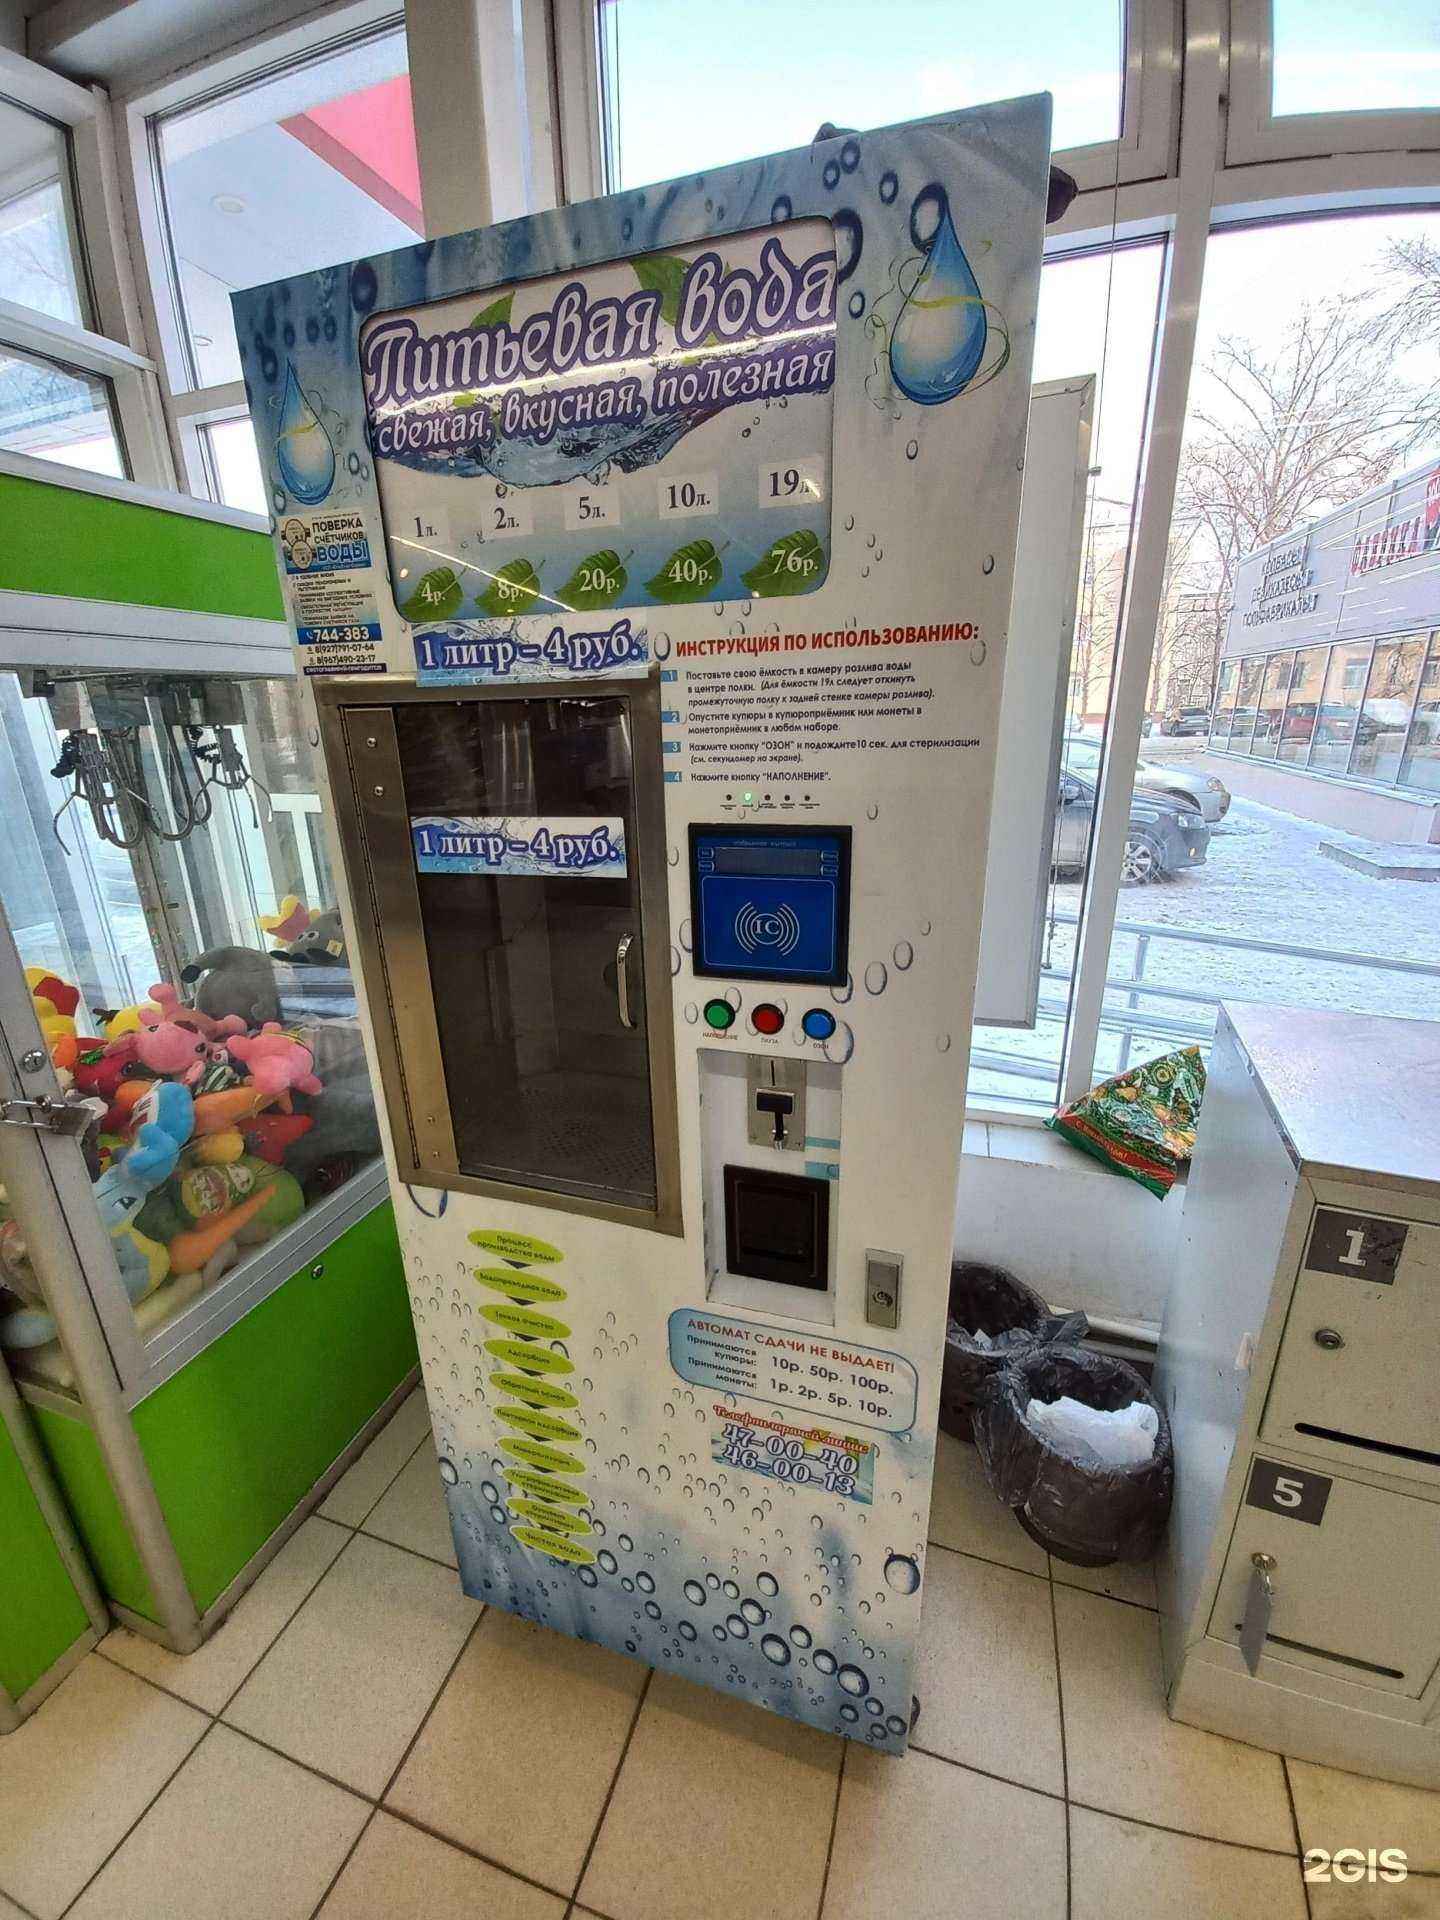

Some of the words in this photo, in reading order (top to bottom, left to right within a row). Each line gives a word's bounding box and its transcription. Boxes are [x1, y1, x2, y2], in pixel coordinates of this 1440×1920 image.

[365, 287, 658, 402] Питьевая
[679, 244, 837, 345] вода
[378, 409, 491, 453] свежая,
[504, 384, 643, 439] вкусная,
[655, 349, 834, 409] полезная
[769, 469, 816, 497] 19л
[578, 496, 606, 520] 5л.
[666, 482, 711, 510] 10л.
[312, 518, 364, 533] ПОВЕРКА
[413, 516, 438, 538] 1л.
[493, 507, 520, 530] 2л.
[314, 531, 364, 545] СЧЁТЧИКОВ
[316, 540, 369, 563] ВОДЫ
[770, 547, 819, 577] 76р.
[578, 568, 620, 595] 20р.
[668, 559, 713, 586] 40р.
[421, 582, 446, 606] 4р.
[497, 578, 524, 602] 8р.
[313, 627, 370, 643] 744-383
[676, 635, 780, 657] ИНСТРУКЦИЯ
[784, 633, 807, 651] ПО
[811, 622, 979, 649] ИСПОЛЬЗОВАНИЮ:
[421, 639, 436, 667] 1
[443, 639, 514, 673] литр
[547, 630, 566, 661] 4
[571, 622, 639, 669] руб.
[733, 670, 757, 679] свою
[759, 667, 797, 677] ёмкость
[806, 665, 842, 676] камеру
[886, 662, 912, 672] воды
[694, 685, 727, 695] центре
[761, 680, 779, 691] (Для
[781, 679, 818, 689] ёмкости
[836, 676, 874, 687] следует
[875, 675, 916, 686] откинуть
[688, 697, 755, 707] промежуточную
[756, 695, 781, 705] полку
[789, 693, 820, 703] задней
[821, 693, 852, 702] стенке
[854, 691, 890, 702] камеры
[689, 712, 730, 723] Опустите
[731, 711, 766, 722] купюры
[775, 707, 856, 720] купюроприёмник
[876, 707, 914, 717] монеты
[688, 725, 762, 735] монетоприёмник
[771, 723, 802, 732] любом
[803, 721, 841, 732] наборе.
[689, 743, 728, 752] Нажмите
[729, 743, 759, 753] кнопку
[868, 740, 888, 749] сек.
[890, 740, 908, 749] для
[909, 738, 980, 749] стерилизации
[690, 755, 705, 765] (см.
[707, 754, 754, 764] секундомер
[768, 753, 803, 765] экране).
[691, 773, 729, 782] Нажмите
[731, 773, 761, 783] кнопку
[419, 830, 433, 853] 1
[439, 835, 504, 862] литр
[533, 831, 550, 856] 4
[556, 828, 617, 866] руб.
[754, 919, 780, 935] IC
[1338, 1229, 1367, 1267] 1
[687, 1334, 757, 1356] Принимаются
[687, 1319, 751, 1341] АВТОМАТ
[754, 1333, 805, 1353] СДАЧИ
[810, 1344, 828, 1357] НЕ
[832, 1349, 895, 1373] ВЫДАЕТ!
[688, 1356, 757, 1379] Принимаются
[714, 1351, 757, 1366] купюры:
[715, 1373, 757, 1390] монеты:
[772, 1356, 804, 1374] 10р.
[809, 1365, 843, 1383] 50р.
[850, 1374, 894, 1395] 100р.
[770, 1378, 793, 1394] 1р.
[798, 1385, 822, 1401] 2р.
[827, 1392, 852, 1408] 5р.
[858, 1399, 893, 1418] 10р.
[721, 1422, 859, 1475] 47-00-40
[722, 1444, 855, 1496] 46-00-13
[1272, 1476, 1305, 1508] 5
